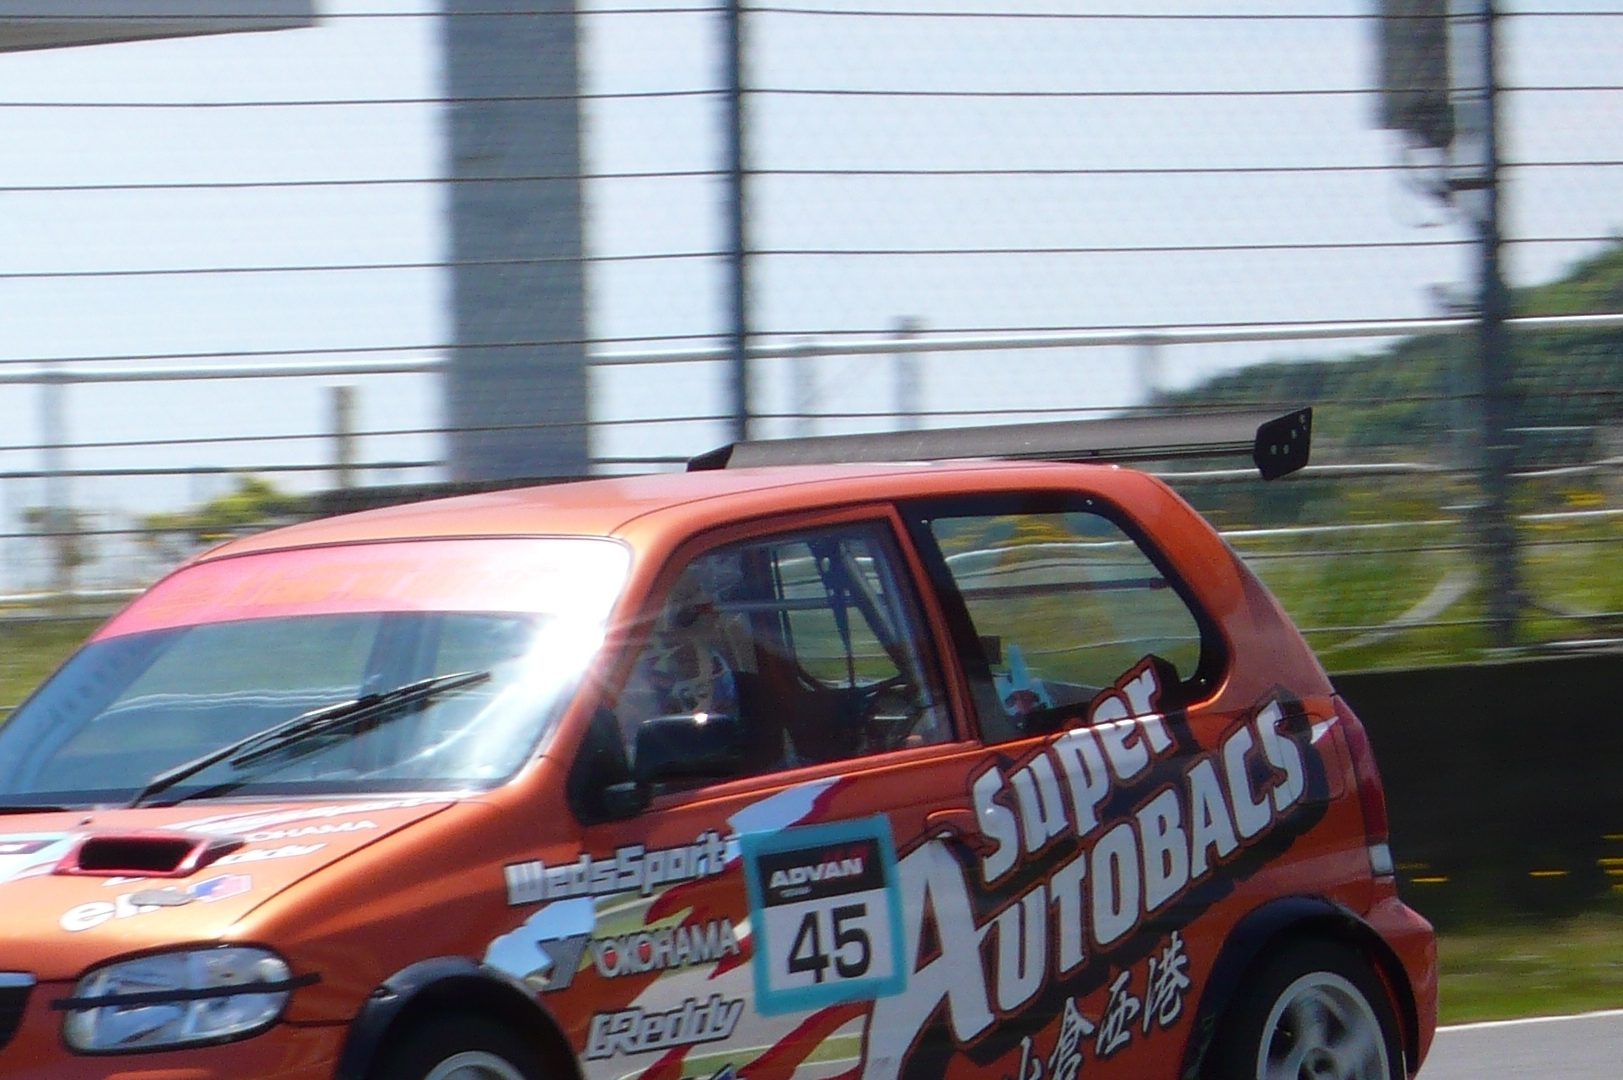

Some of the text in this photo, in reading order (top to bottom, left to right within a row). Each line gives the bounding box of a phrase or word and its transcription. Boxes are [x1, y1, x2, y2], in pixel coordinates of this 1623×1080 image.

[973, 667, 1174, 882] Super
[504, 831, 726, 905] WedsSport
[768, 857, 863, 889] ADVAN
[787, 903, 872, 984] 45
